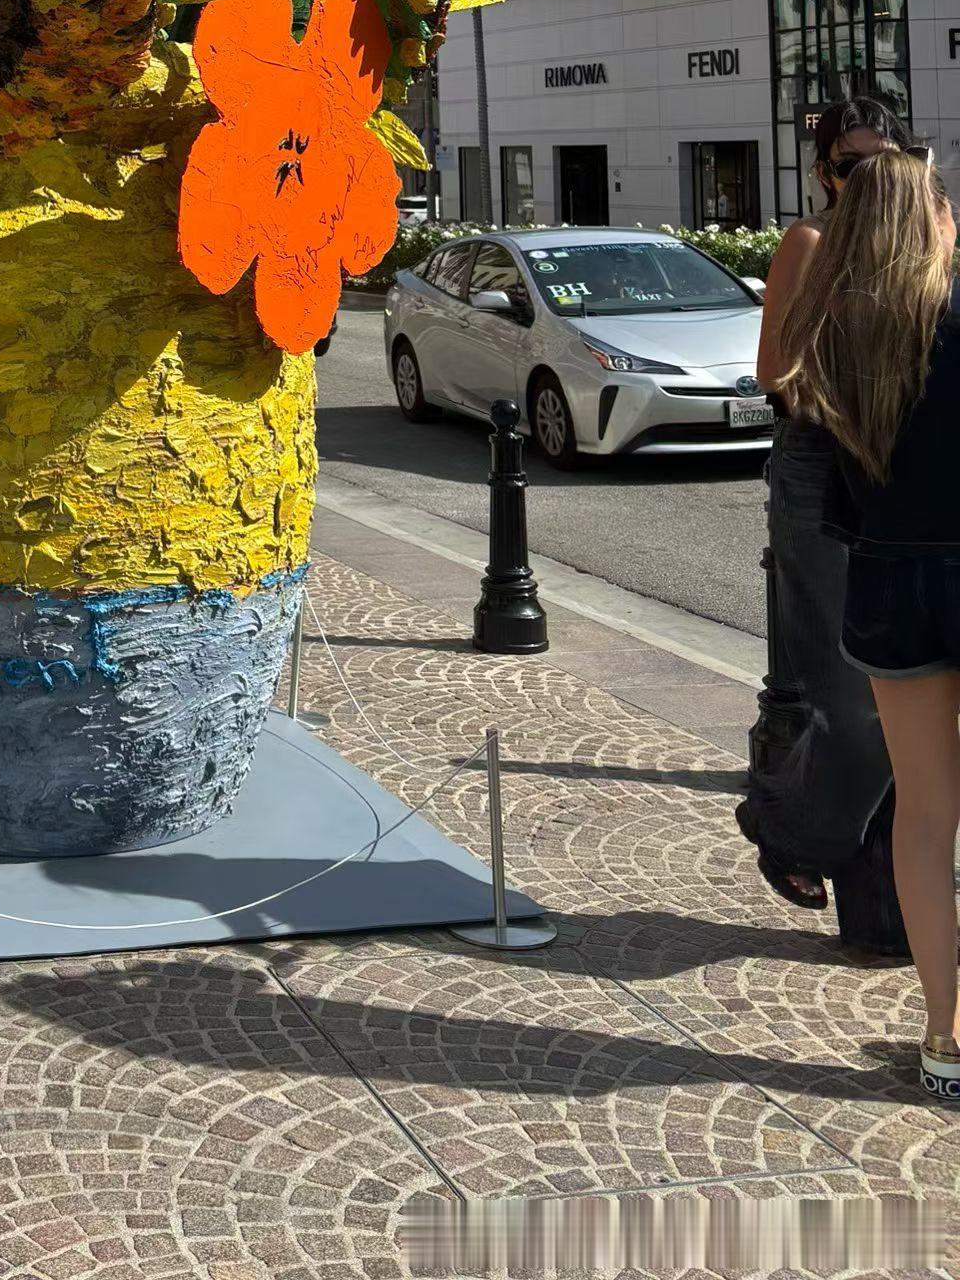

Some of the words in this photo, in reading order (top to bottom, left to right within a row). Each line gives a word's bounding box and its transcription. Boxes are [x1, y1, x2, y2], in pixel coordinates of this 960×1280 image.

[544, 62, 608, 88] RIMOWA
[688, 48, 740, 78] FENDI
[546, 282, 593, 298] BH
[920, 1068, 960, 1097] OLC
